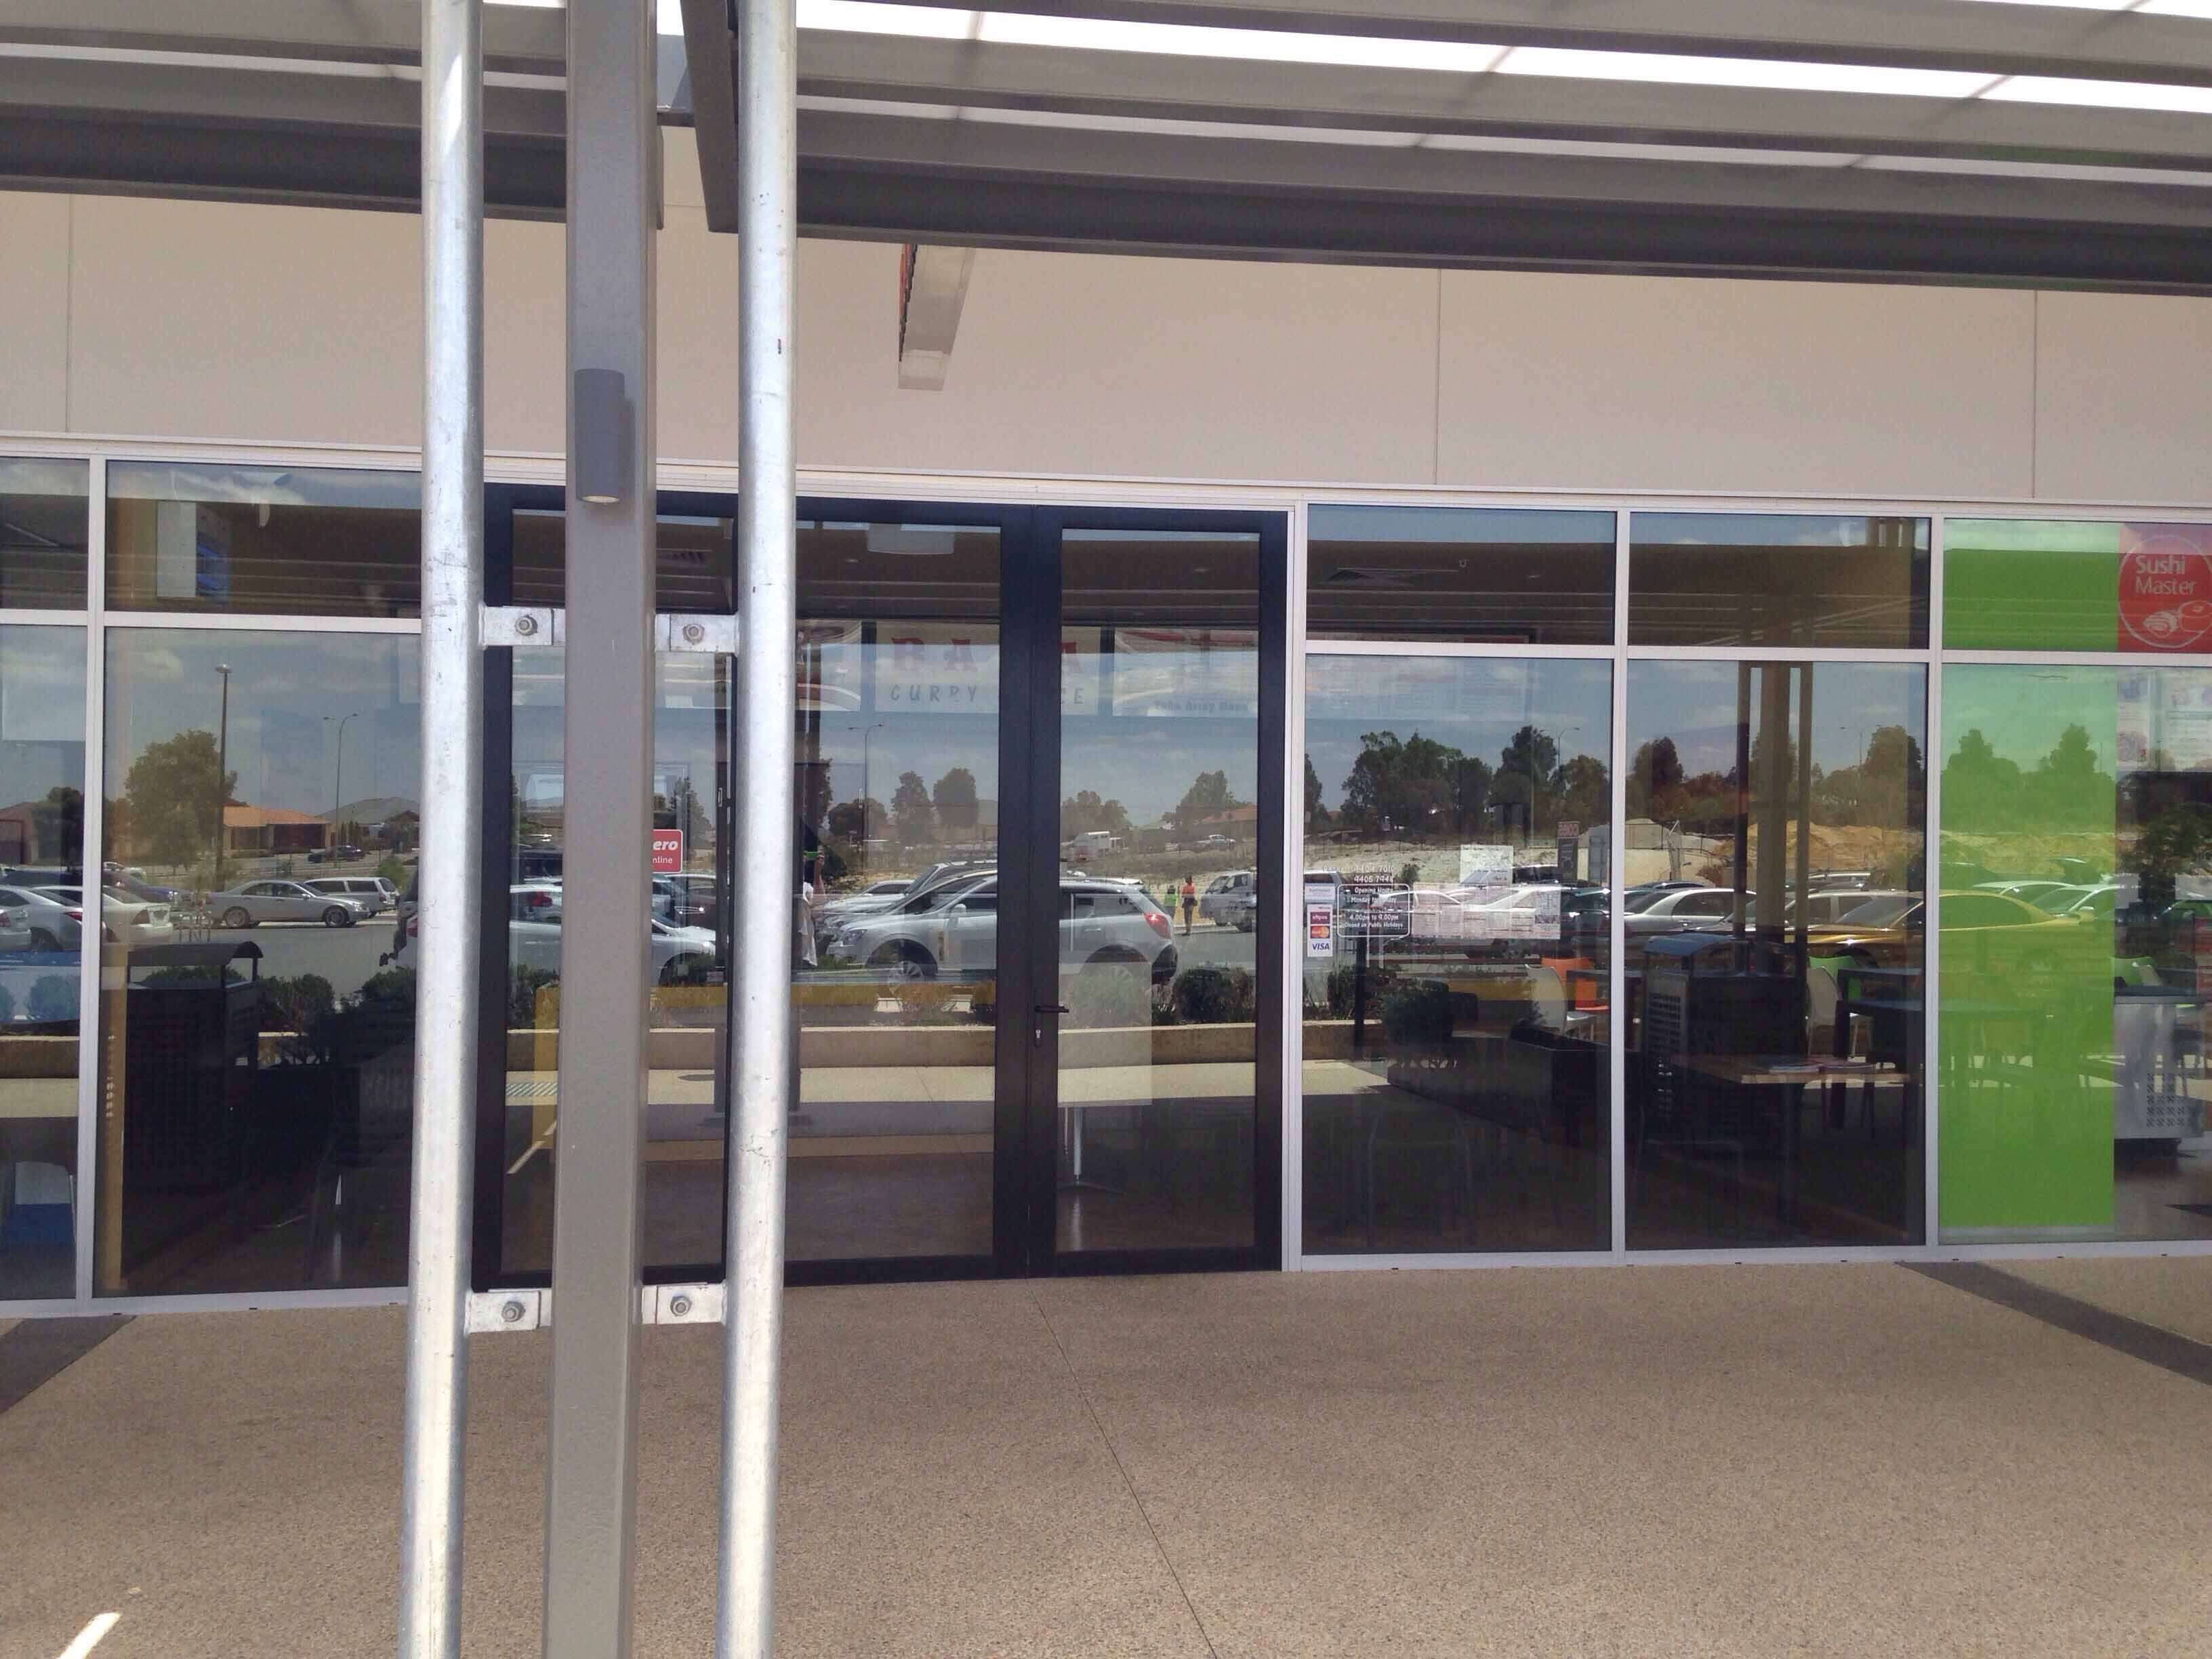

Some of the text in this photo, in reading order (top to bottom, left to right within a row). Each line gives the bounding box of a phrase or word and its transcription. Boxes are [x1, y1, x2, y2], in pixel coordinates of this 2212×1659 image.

[2135, 554, 2186, 575] Sushi
[2135, 576, 2197, 595] Master
[890, 684, 977, 702] CURRY
[653, 840, 678, 851] ero
[1354, 875, 1373, 883] 9405
